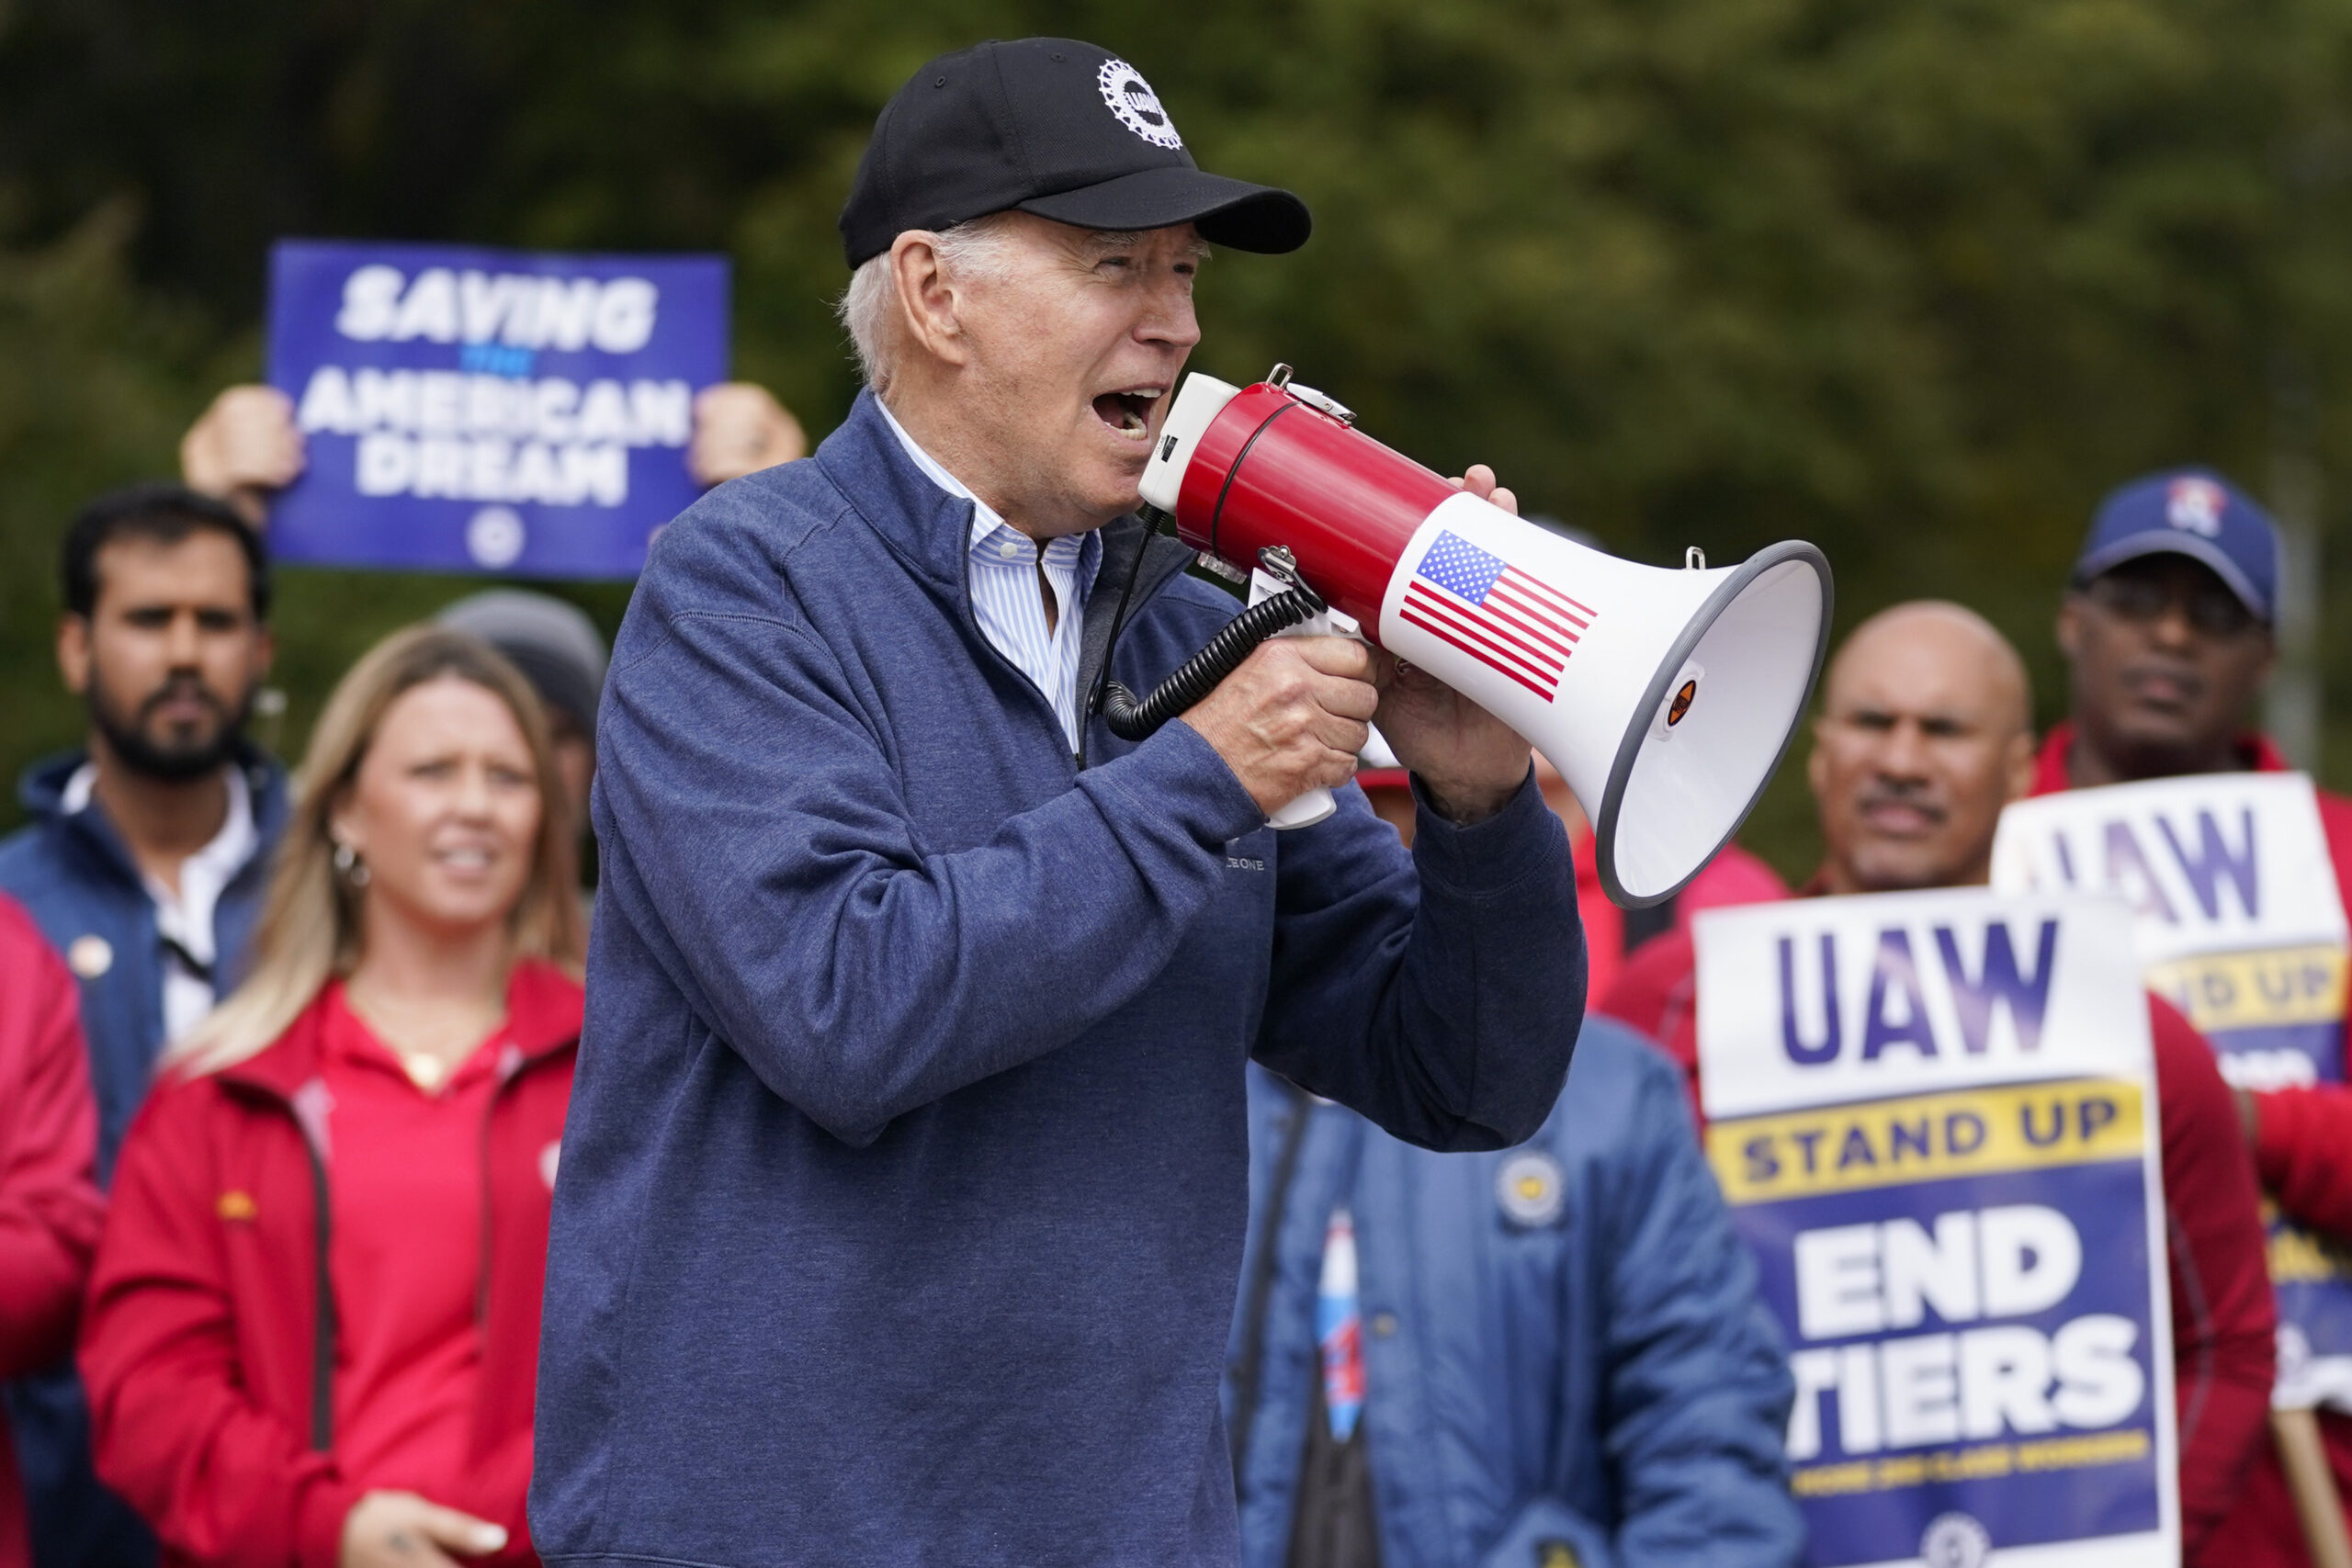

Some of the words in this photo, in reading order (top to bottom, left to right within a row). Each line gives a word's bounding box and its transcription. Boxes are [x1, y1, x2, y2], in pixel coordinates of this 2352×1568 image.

[336, 265, 658, 354] SAVING
[299, 367, 692, 446] AMERICAN
[356, 436, 628, 506] DREAM
[1778, 920, 2059, 1066] UAW
[1744, 1112, 1986, 1181] STAND
[2020, 1098, 2120, 1147] UP
[1794, 1204, 2083, 1340] END
[1786, 1314, 2145, 1461] TIERS
